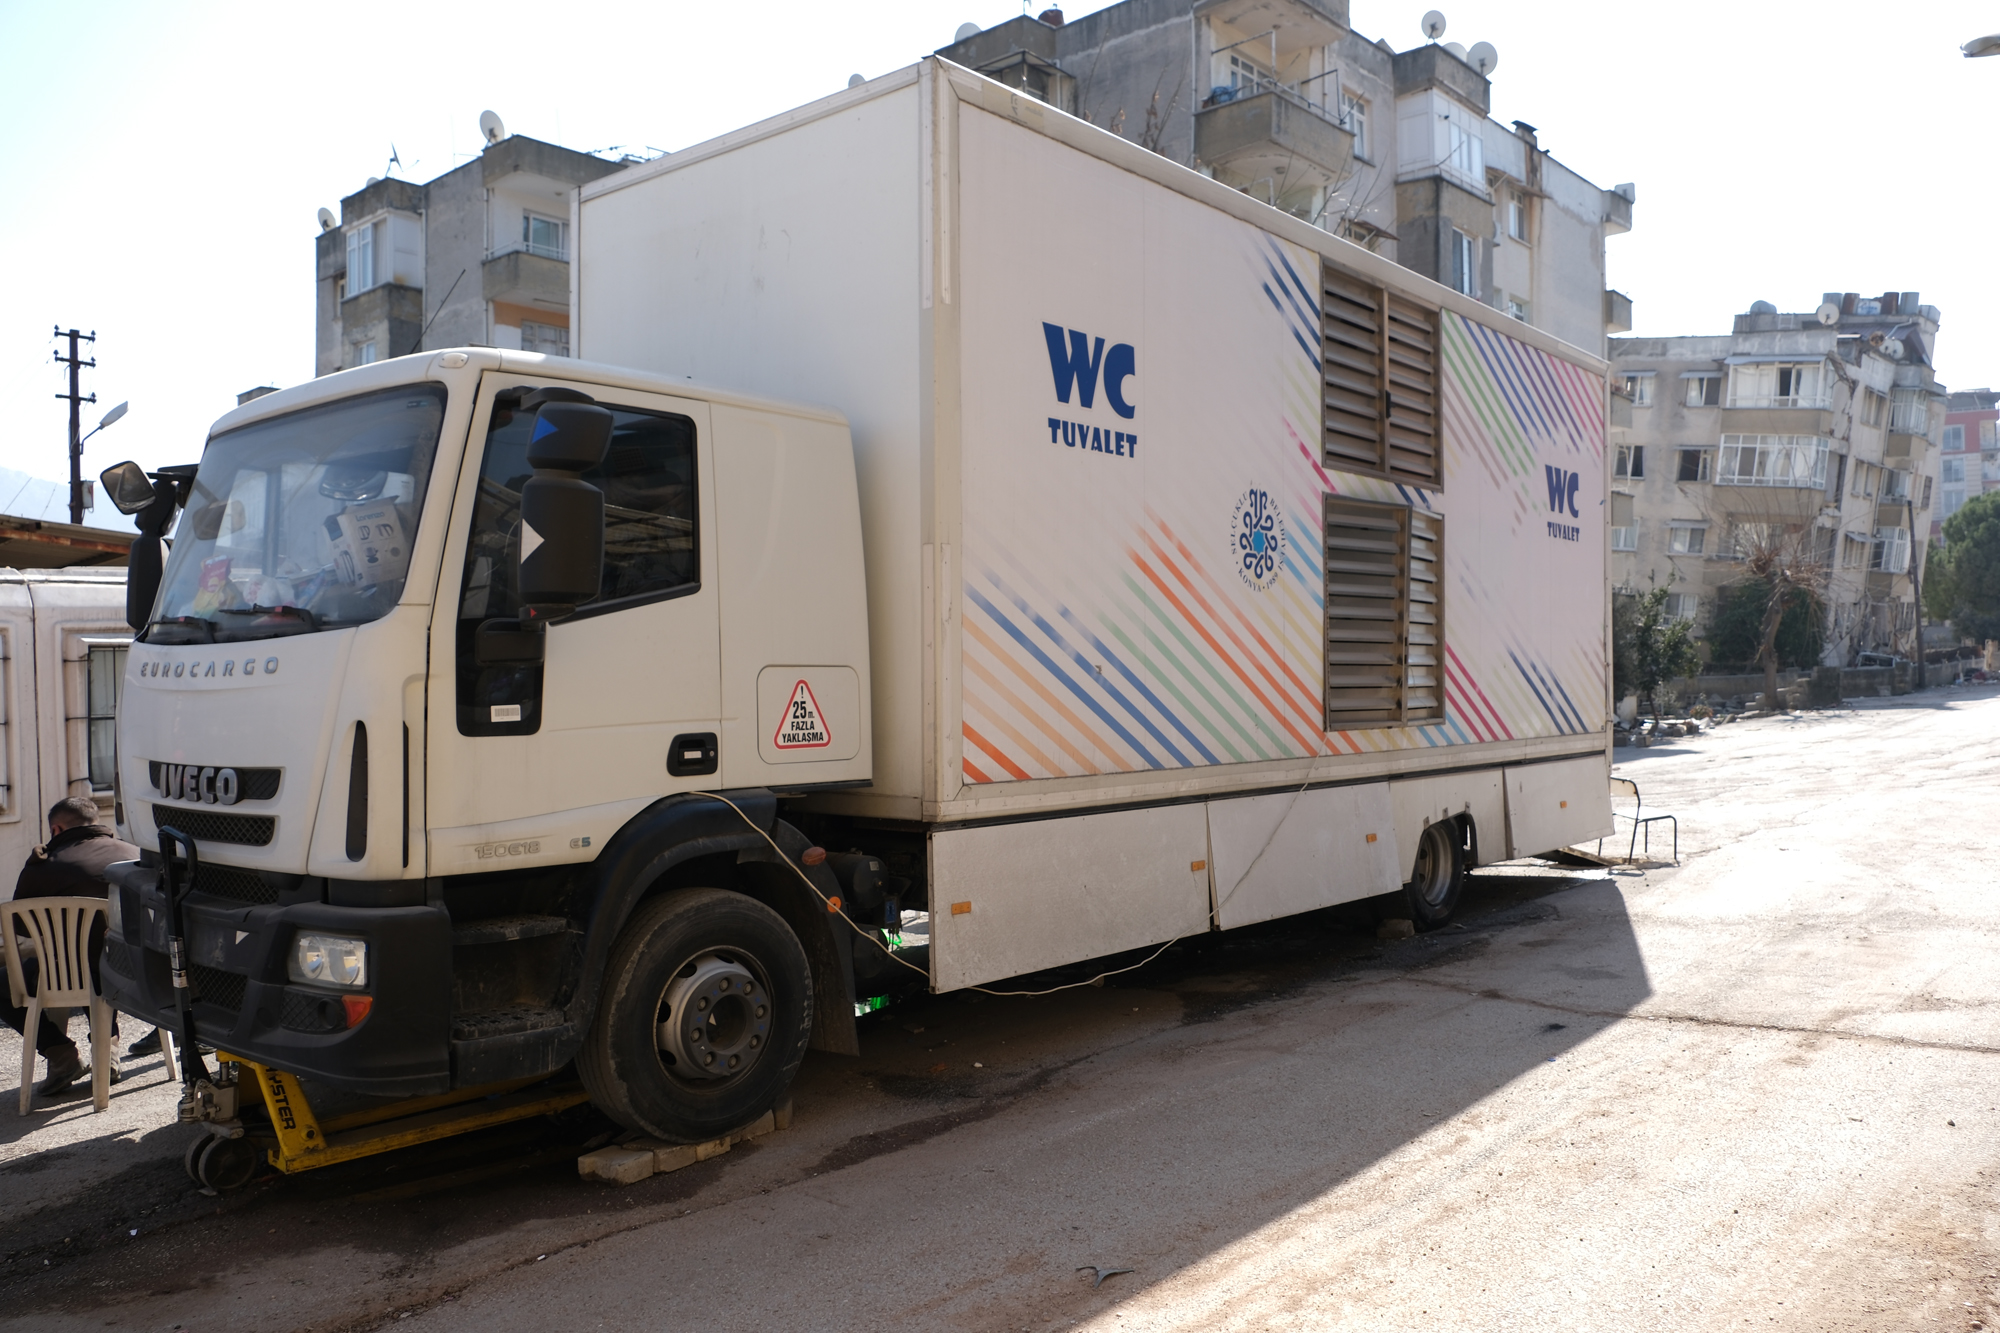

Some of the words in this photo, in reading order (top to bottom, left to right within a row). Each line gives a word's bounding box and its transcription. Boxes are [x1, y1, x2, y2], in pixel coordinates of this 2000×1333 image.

[1042, 321, 1136, 419] WC
[1048, 416, 1138, 459] TUVALET
[1545, 464, 1579, 518] WC
[1547, 521, 1579, 541] TUVALET
[1238, 567, 1262, 592] KONYA
[140, 656, 279, 678] EUROCARGO
[791, 720, 815, 731] FAZLA
[782, 732, 824, 743] YAKLAŞMA
[159, 763, 239, 805] IVECO
[475, 840, 541, 859] 150E18
[570, 837, 591, 849] E5
